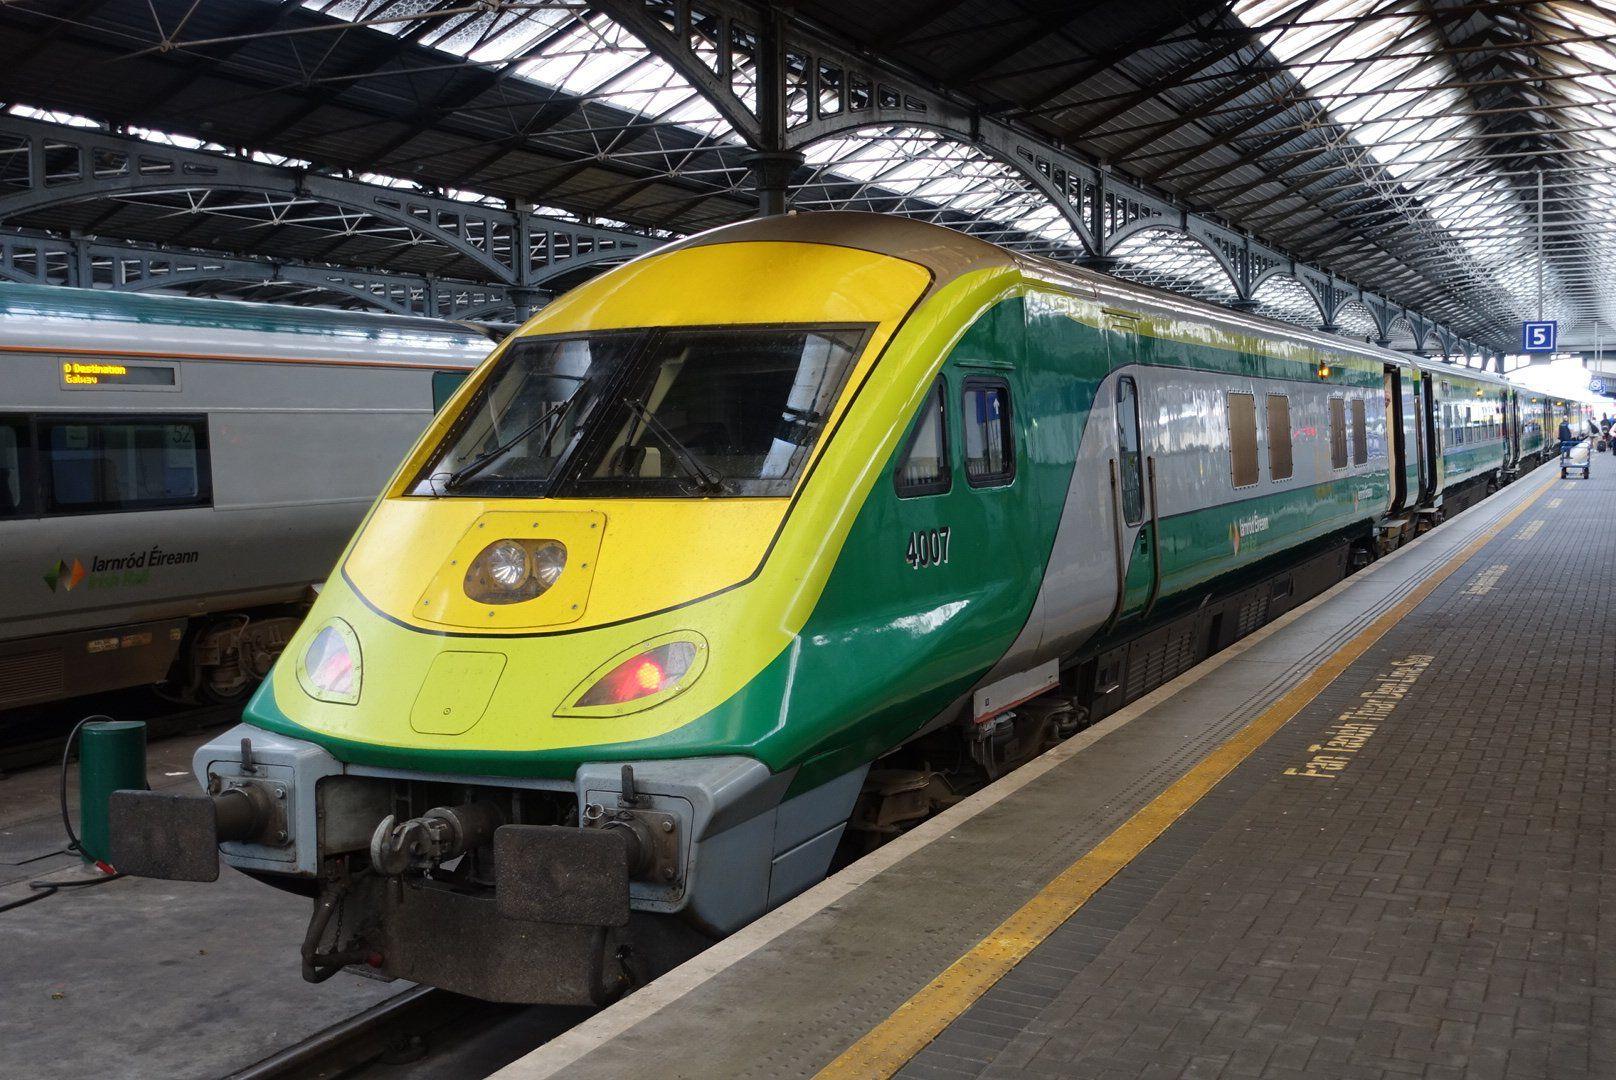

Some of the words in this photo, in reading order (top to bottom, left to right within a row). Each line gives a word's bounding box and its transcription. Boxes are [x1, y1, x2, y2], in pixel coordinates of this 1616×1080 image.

[1533, 328, 1546, 345] 5
[66, 374, 98, 384] Galway
[74, 364, 126, 375] Destination
[91, 552, 146, 573] Iarnród
[148, 545, 199, 567] Éireann
[905, 526, 951, 570] 4007
[1338, 700, 1397, 721] Thiar
[1307, 724, 1379, 753] Taobh
[1283, 754, 1351, 779] Fan
